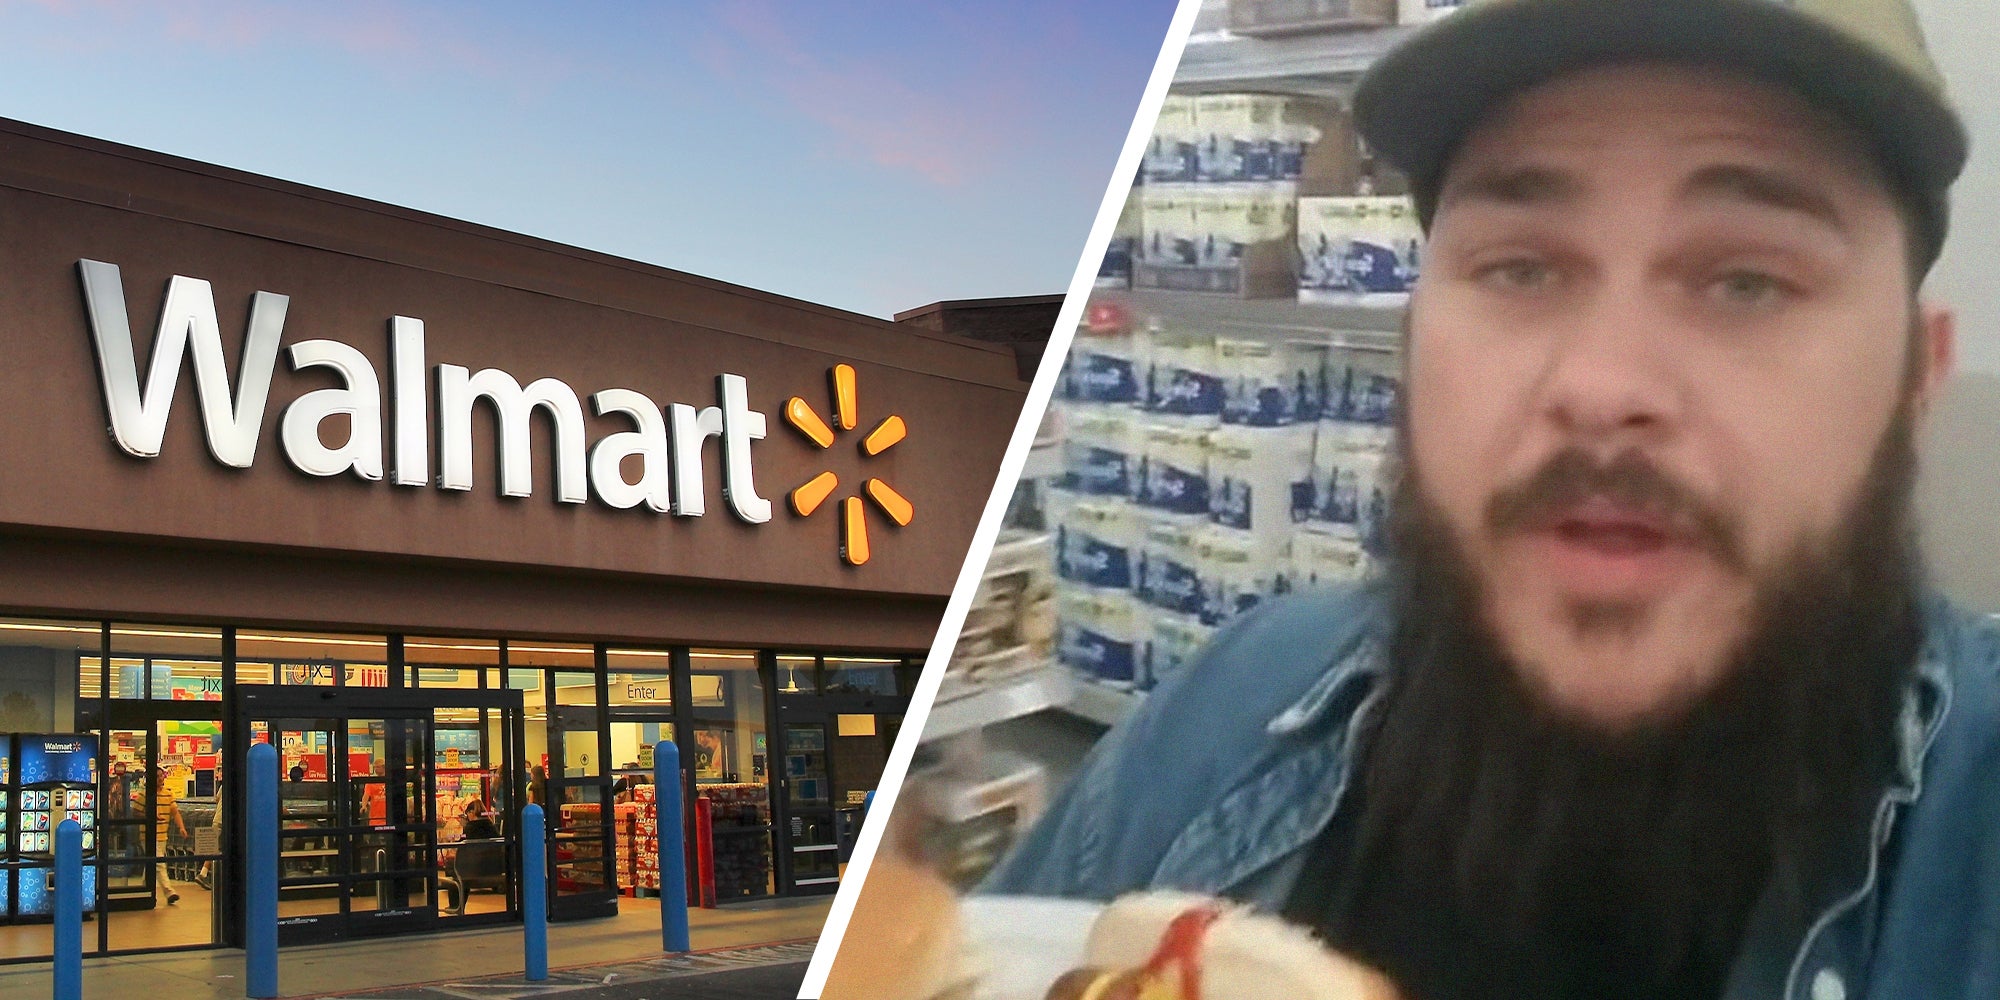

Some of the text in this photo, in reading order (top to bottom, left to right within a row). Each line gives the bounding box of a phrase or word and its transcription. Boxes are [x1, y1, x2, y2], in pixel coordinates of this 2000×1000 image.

[76, 258, 772, 524] Walmart
[627, 683, 656, 699] Enter
[44, 742, 73, 750] Walmart
